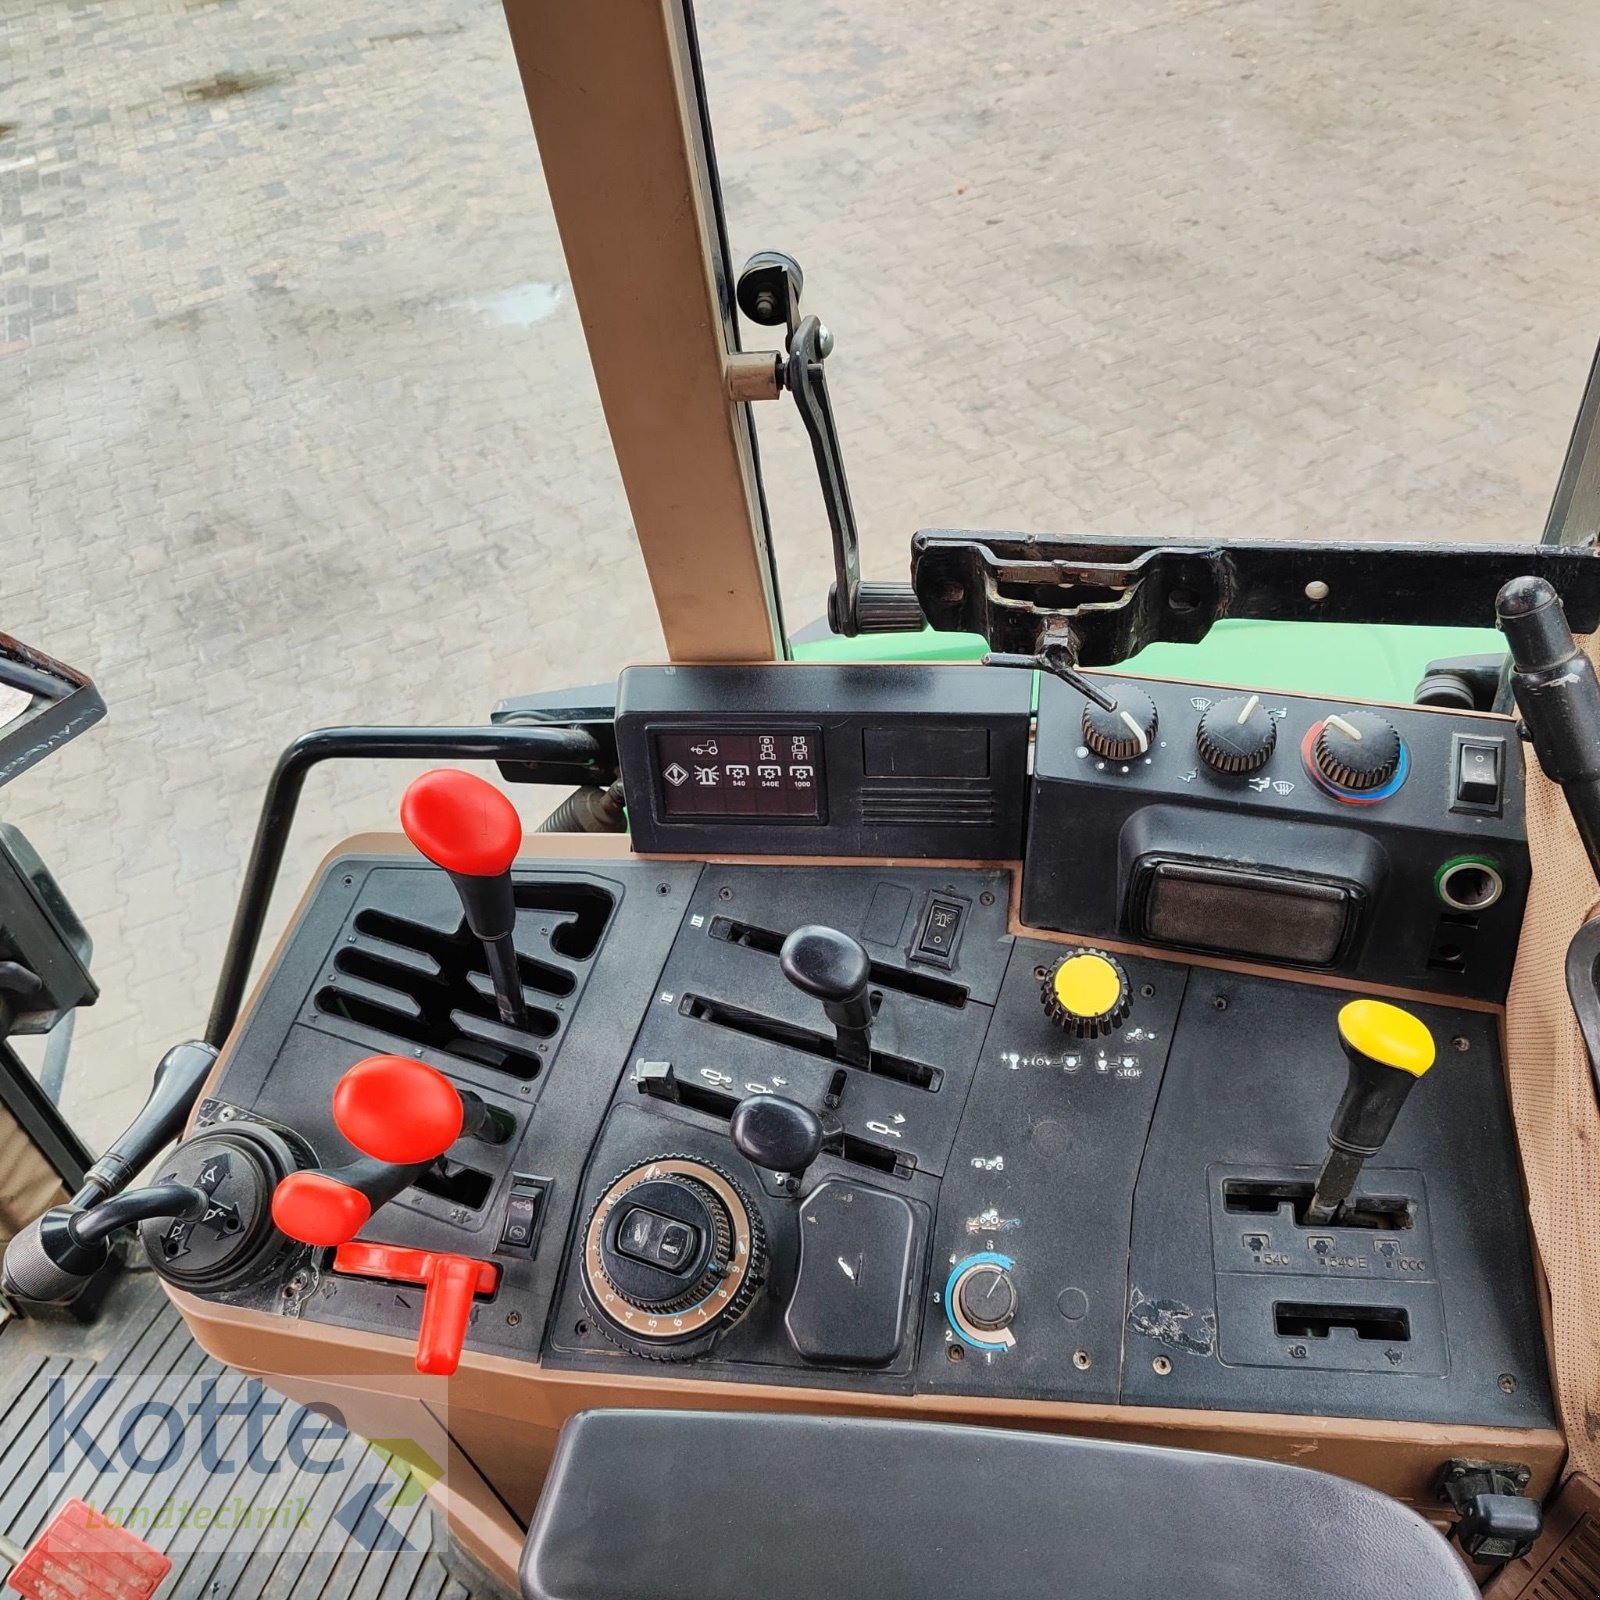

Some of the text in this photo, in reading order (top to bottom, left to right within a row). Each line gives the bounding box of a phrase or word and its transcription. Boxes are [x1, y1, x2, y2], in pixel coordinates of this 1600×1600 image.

[761, 780, 779, 788] 540E
[1116, 1069, 1141, 1078] STOP
[948, 1253, 955, 1264] 4
[605, 1293, 614, 1302] 3
[718, 1290, 727, 1298] 8
[933, 1292, 941, 1303] 3
[625, 1311, 633, 1320] 4
[698, 1308, 706, 1316] 7
[648, 1319, 657, 1328] 5
[945, 1330, 953, 1341] 2
[986, 1352, 992, 1363] 1
